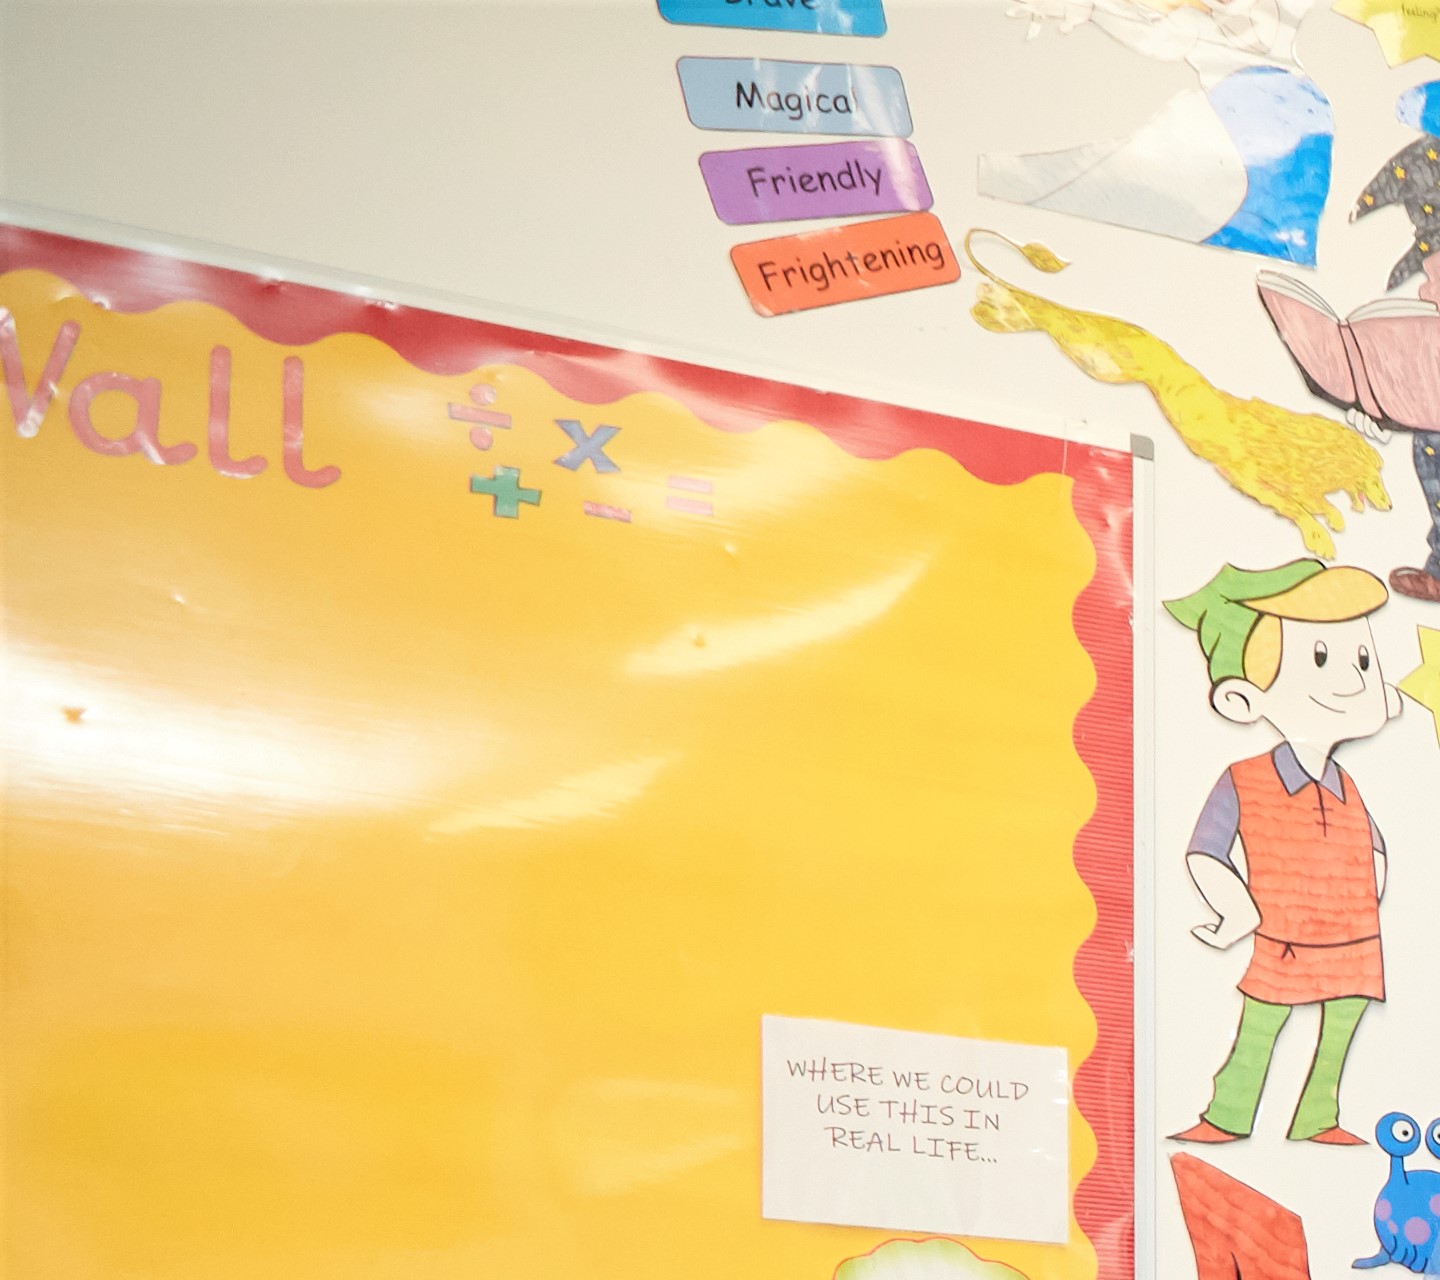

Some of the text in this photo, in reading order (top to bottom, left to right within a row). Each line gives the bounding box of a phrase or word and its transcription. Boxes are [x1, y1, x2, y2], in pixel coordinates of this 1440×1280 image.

[747, 160, 882, 198] Friendly
[758, 240, 946, 291] Frightening
[787, 1057, 1030, 1101] WHERE WE COULD
[816, 1094, 1000, 1132] USE THIS IN
[824, 1126, 998, 1164] REAL LIFE...
